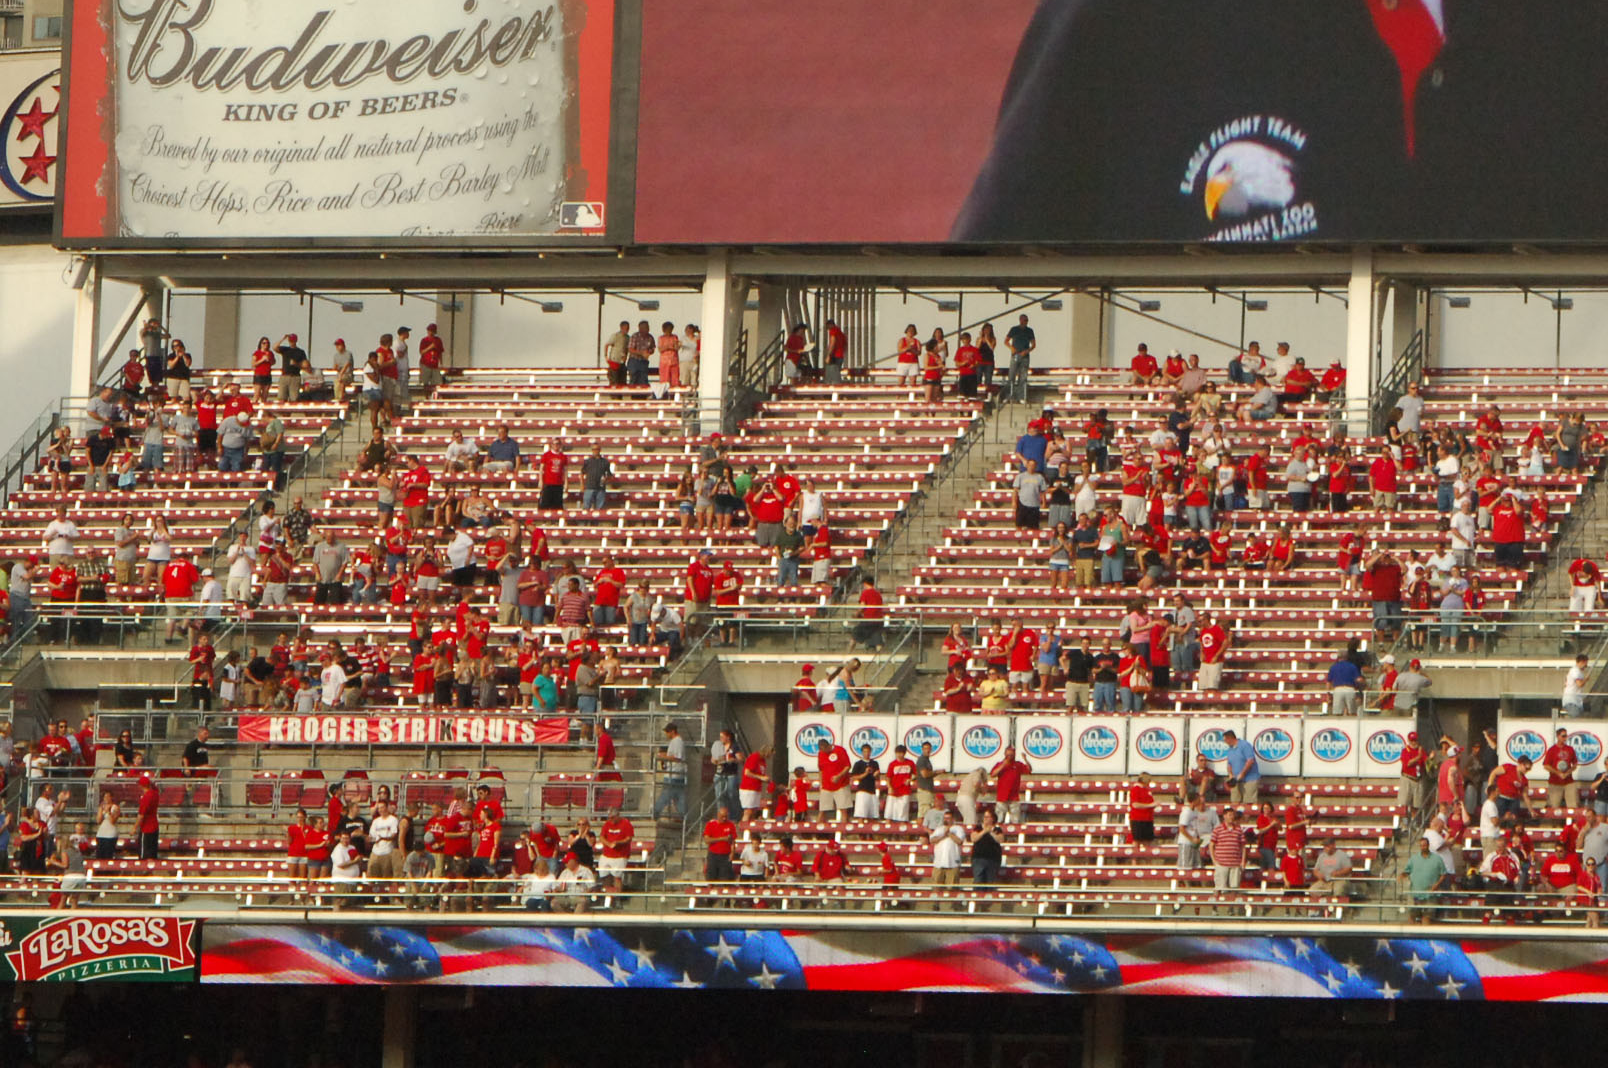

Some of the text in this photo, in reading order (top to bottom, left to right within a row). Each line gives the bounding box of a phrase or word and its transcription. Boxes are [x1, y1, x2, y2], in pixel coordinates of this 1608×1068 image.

[222, 87, 458, 122] KING OF BEERS
[142, 101, 540, 175] Brewed by our original all natural process using the
[1267, 116, 1308, 151] TEAM
[128, 145, 550, 225] Choicest Hops, Rice and Best Barley Malt
[269, 716, 536, 744] KROGER STRIKEOUTS
[966, 729, 1000, 755] Kroger
[1027, 729, 1060, 755] Kroger
[1083, 730, 1116, 756] Kroger
[1141, 732, 1174, 757] Kroger
[1258, 732, 1291, 758] Kroger
[1315, 732, 1348, 758] Kroger
[29, 916, 170, 970] LaRosa's
[58, 958, 151, 981] PIZZERIA
